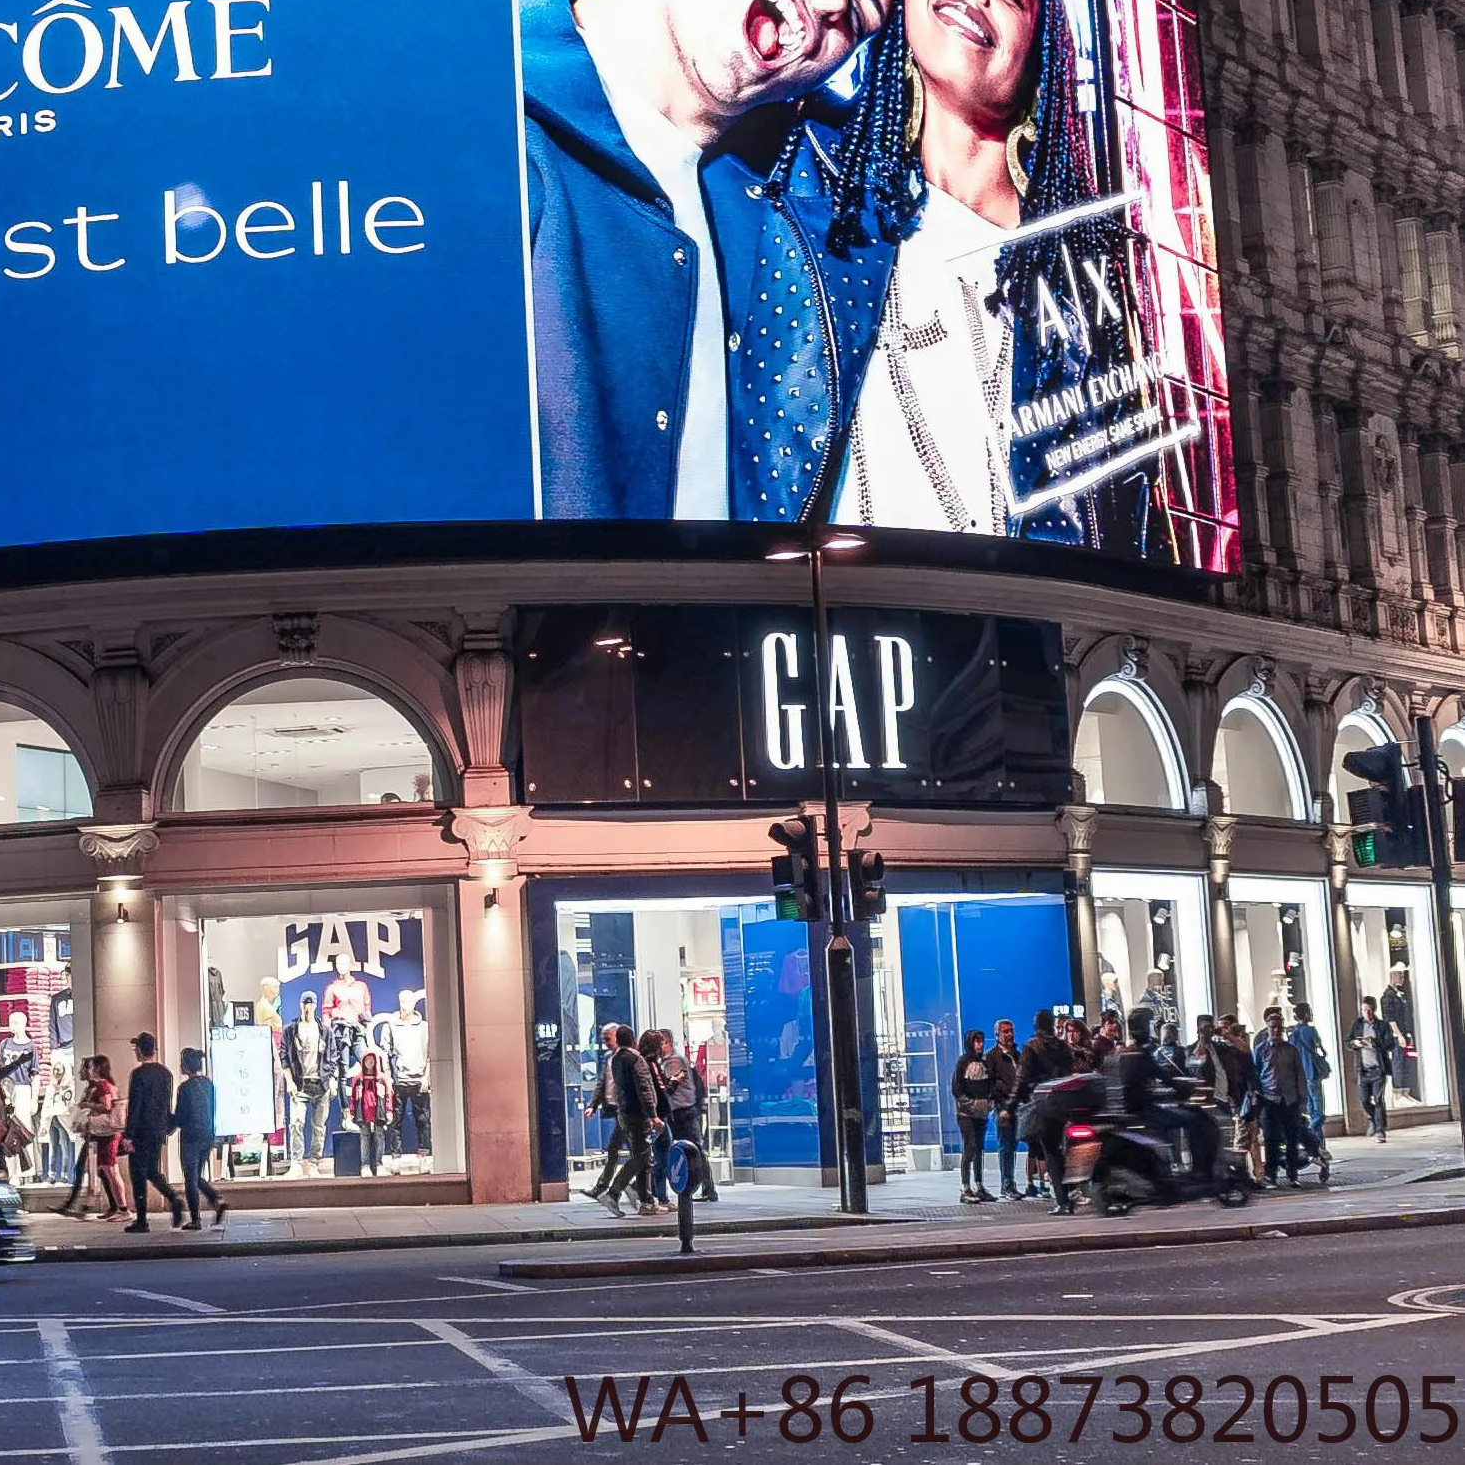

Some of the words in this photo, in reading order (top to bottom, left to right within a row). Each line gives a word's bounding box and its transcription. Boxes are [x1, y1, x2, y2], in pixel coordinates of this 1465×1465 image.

[164, 180, 425, 265] belle
[1010, 385, 1086, 439] ARMANI
[762, 631, 916, 770] GAP
[277, 918, 402, 984] GAP
